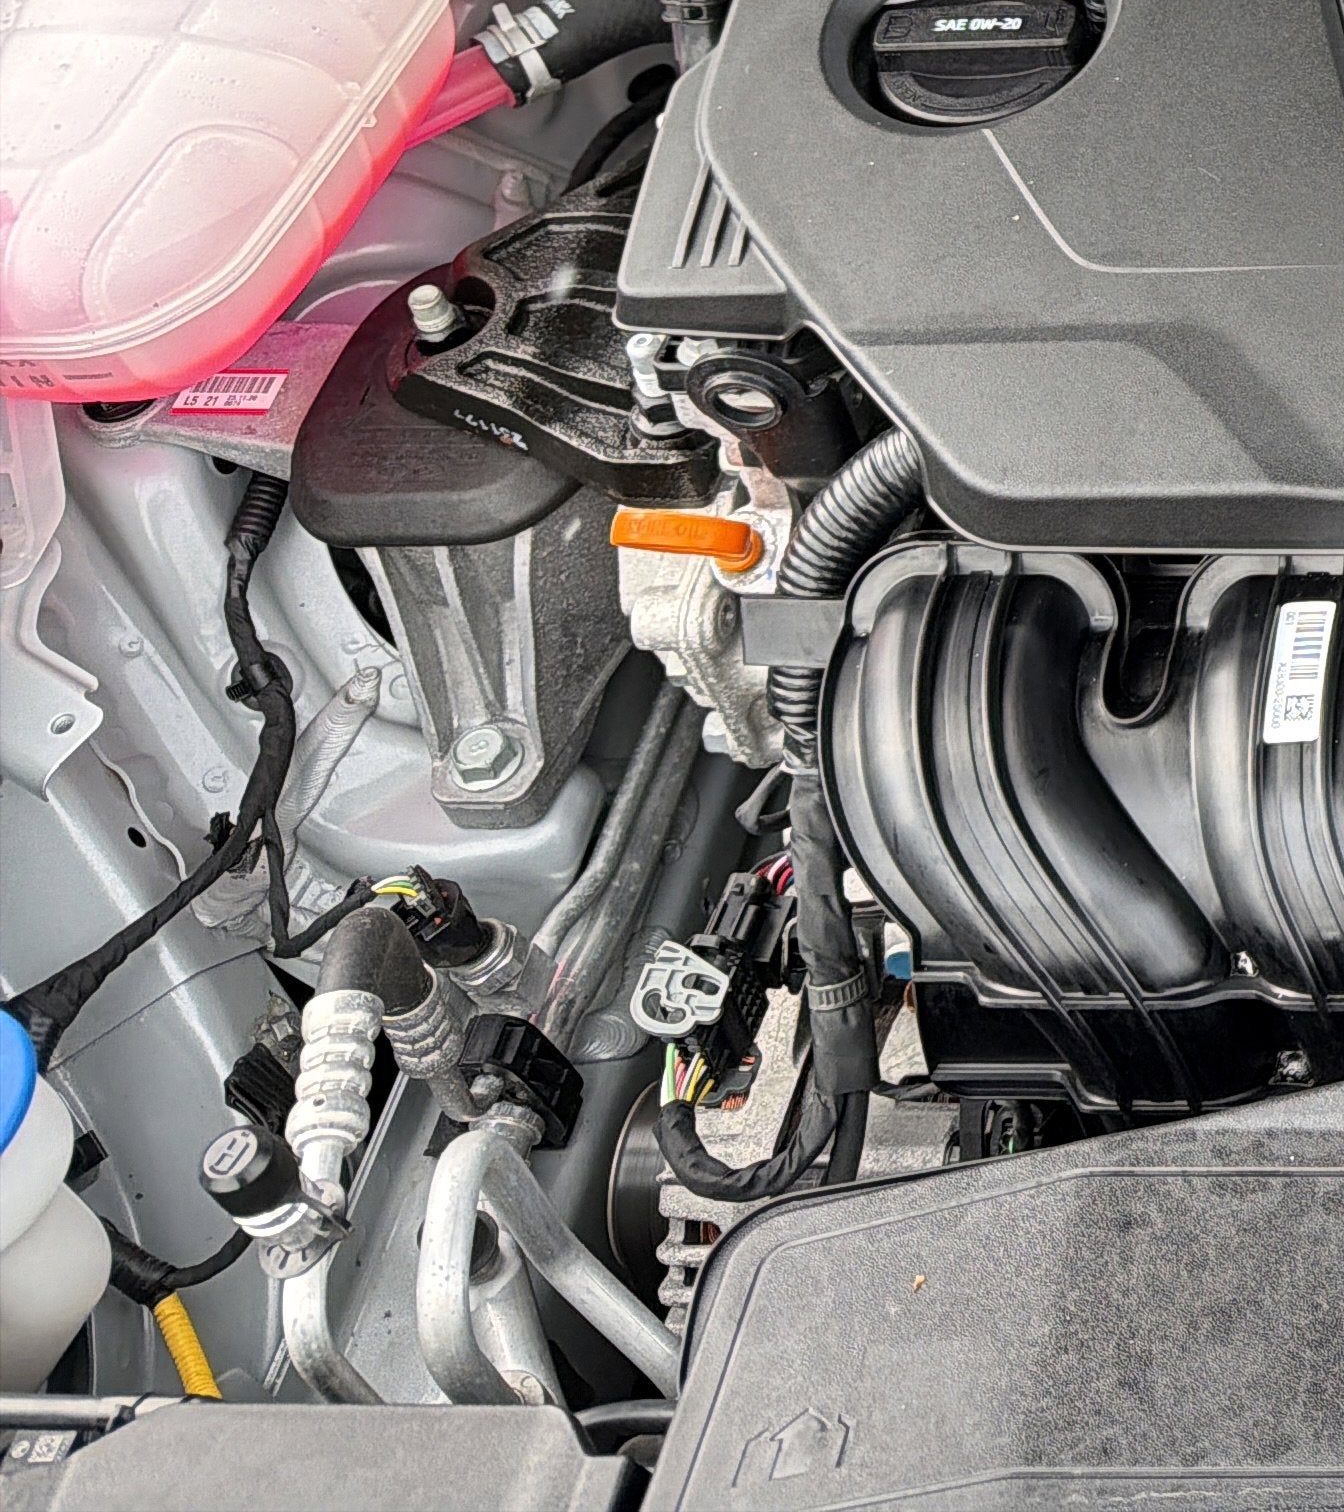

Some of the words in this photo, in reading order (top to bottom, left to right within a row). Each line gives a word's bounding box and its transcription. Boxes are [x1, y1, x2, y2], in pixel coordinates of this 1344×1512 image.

[930, 18, 968, 32] SAE
[969, 16, 1023, 31] 0W-20
[183, 395, 200, 407] L5
[203, 395, 220, 407] 21
